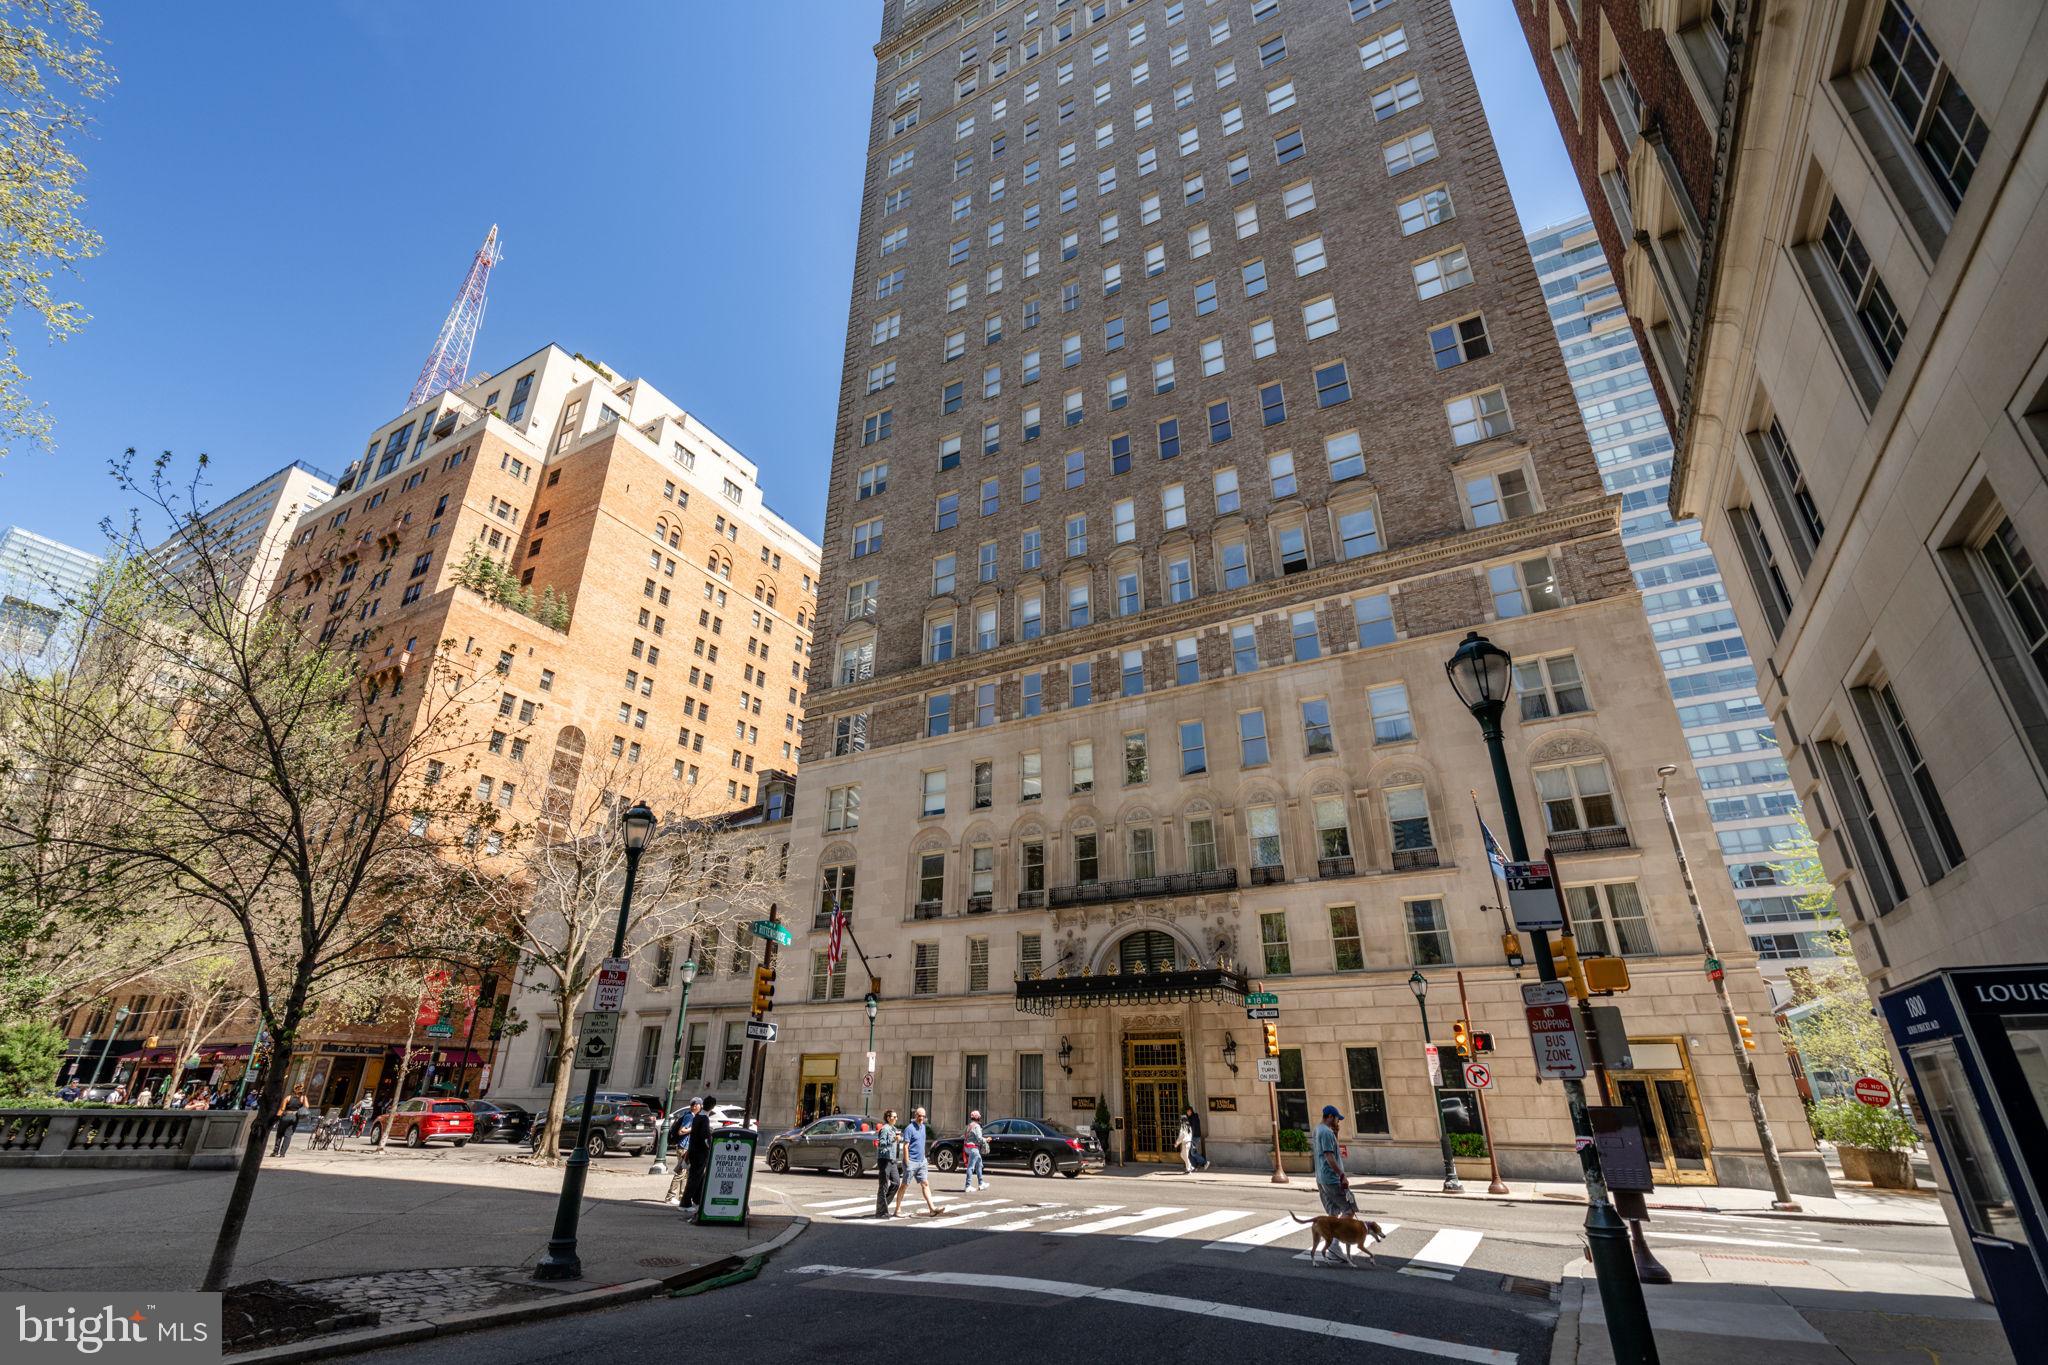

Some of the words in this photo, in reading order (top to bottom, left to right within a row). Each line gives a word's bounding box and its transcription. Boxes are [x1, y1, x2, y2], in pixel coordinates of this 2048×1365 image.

[1509, 878, 1525, 890] 12
[608, 971, 619, 980] NO
[600, 978, 625, 986] STOPPING
[1975, 982, 2048, 1003] LOUIS
[1543, 1007, 1555, 1018] NO
[1905, 995, 1927, 1018] 1800
[1532, 1018, 1570, 1030] STOPPING
[749, 1026, 759, 1035] ONE
[1545, 1035, 1566, 1047] BUS
[1545, 1049, 1573, 1062] ZONE
[1862, 1095, 1884, 1103] ENTER
